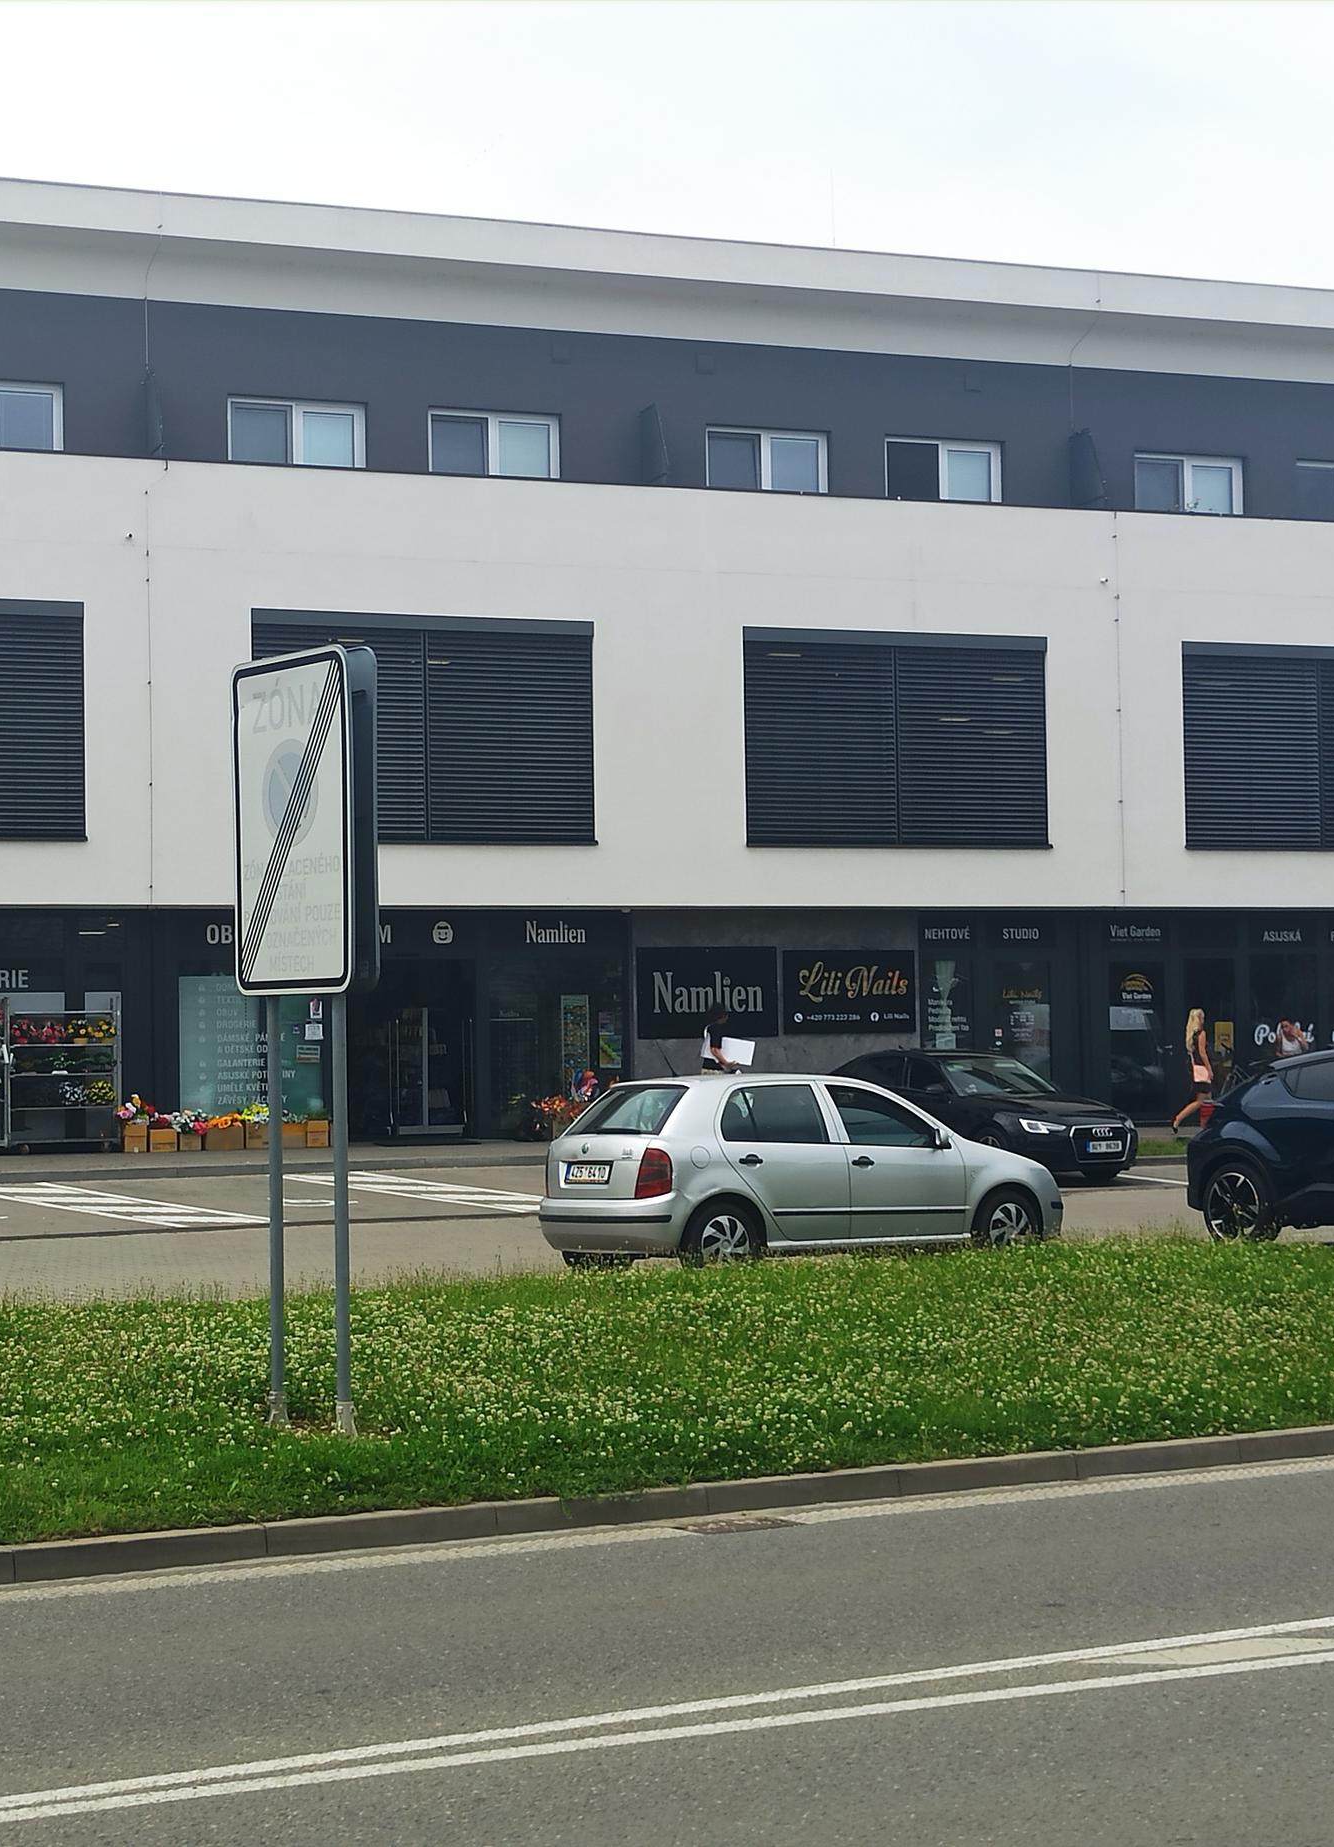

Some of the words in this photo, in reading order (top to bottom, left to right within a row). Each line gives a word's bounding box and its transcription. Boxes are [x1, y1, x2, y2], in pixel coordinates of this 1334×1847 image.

[525, 921, 587, 944] Namlien
[924, 925, 970, 940] NEHTOVÉ
[1002, 928, 1040, 940] STUDIO
[1110, 925, 1128, 937] Viet
[1130, 925, 1161, 937] Garden
[1262, 929, 1302, 942] ASIJSKÁ
[269, 951, 315, 973] MÍSTECH
[798, 961, 843, 1002] Lili
[845, 965, 909, 999] Nails
[652, 971, 764, 1013] Namlien
[217, 1020, 258, 1029] DROGERIE
[217, 1059, 265, 1068] GALANTERIE
[217, 1070, 250, 1079] ASIJSKÉ
[217, 1082, 244, 1092] UMĚLÉ
